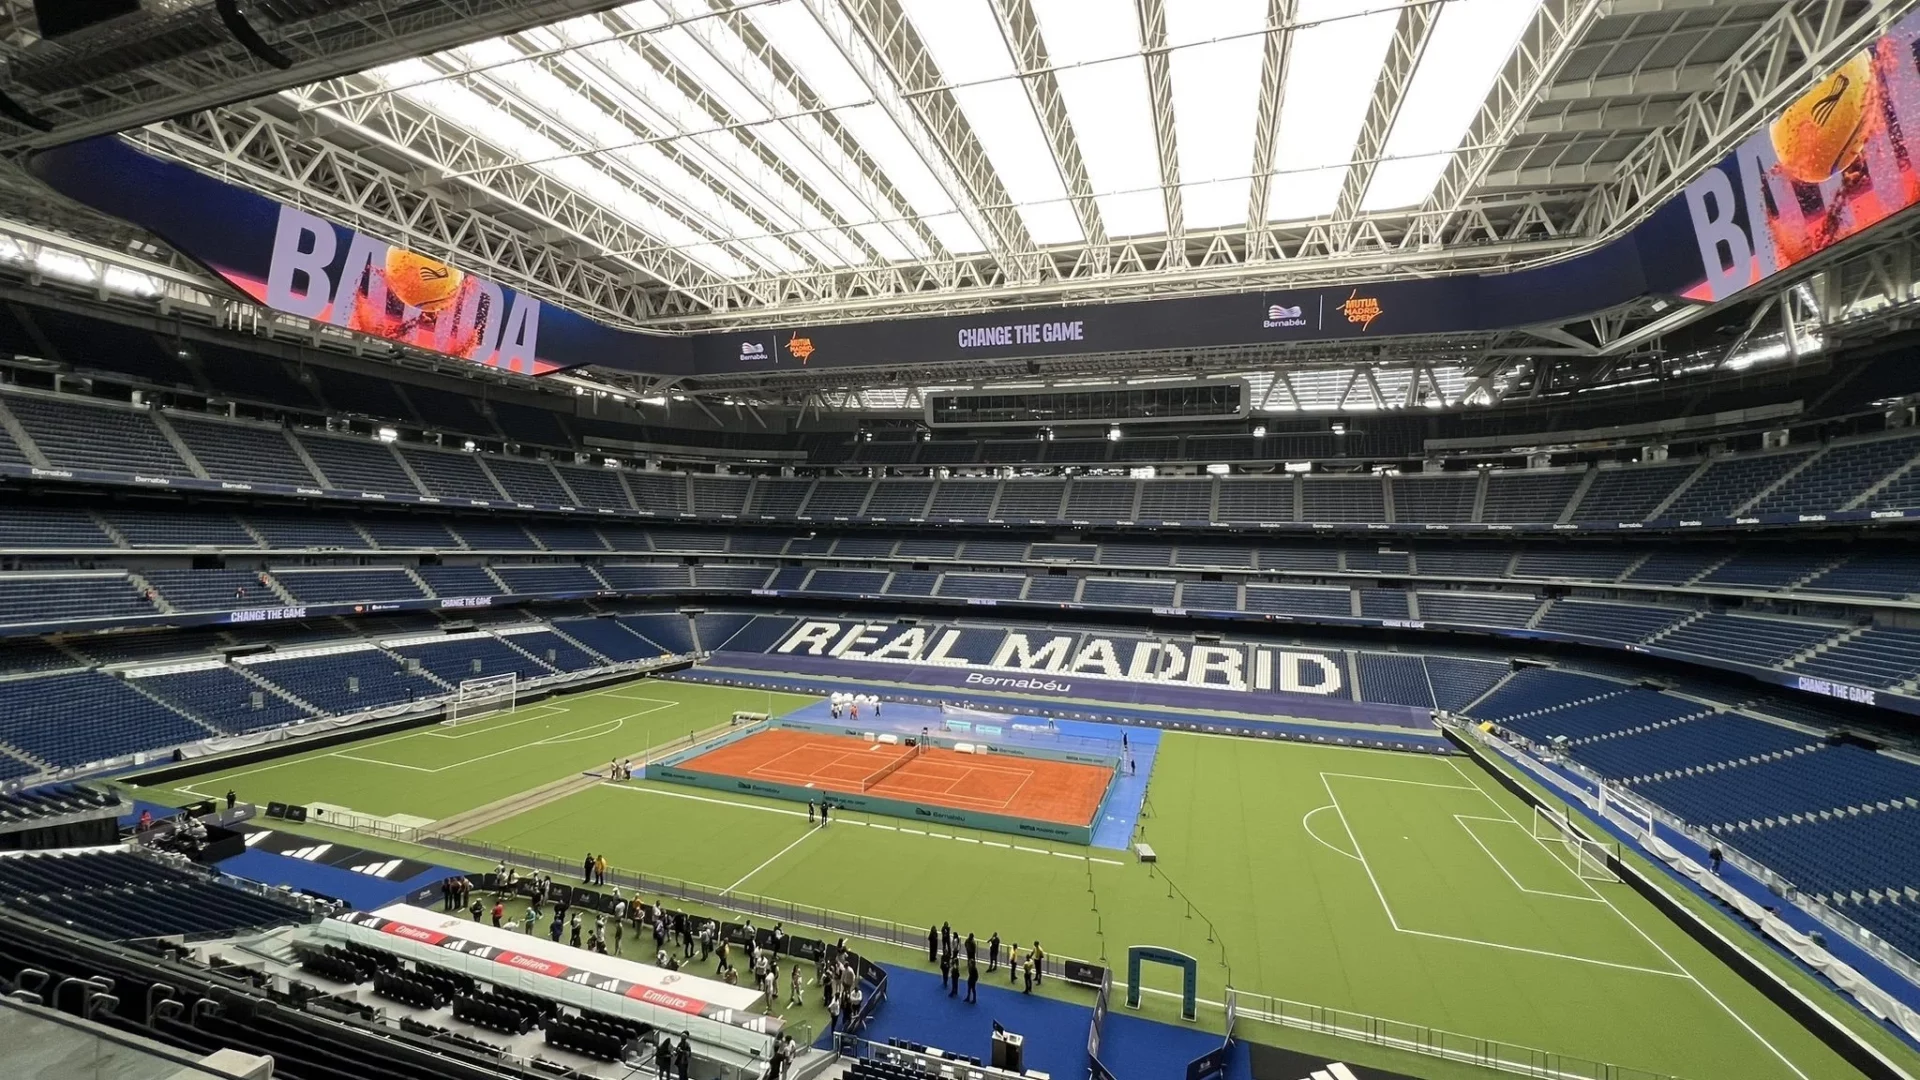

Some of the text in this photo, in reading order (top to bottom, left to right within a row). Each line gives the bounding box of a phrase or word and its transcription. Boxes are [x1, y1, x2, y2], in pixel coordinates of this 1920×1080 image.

[1345, 298, 1378, 309] MUTUA
[1344, 307, 1380, 316] MADRID
[1263, 319, 1306, 328] Bernabéu
[1348, 313, 1374, 323] OPEN
[958, 321, 1084, 348] CHANGE THE GAME
[740, 353, 768, 361] Bernabéu
[32, 468, 72, 478] Bernabéu
[135, 476, 169, 485] Bernabéu
[221, 482, 251, 490] Bernabéu
[441, 597, 492, 608] CHANGE THE GAME
[231, 607, 306, 622] CHANGE THE GAME
[777, 620, 1342, 696] REAL MADRID
[965, 672, 1071, 692] Bernabéu
[1799, 676, 1875, 706] CHANGE THE GAME
[932, 811, 966, 822] Bernabéu
[395, 925, 432, 940] Emirates
[510, 955, 551, 971] Emirates
[642, 989, 688, 1008] Emirates
